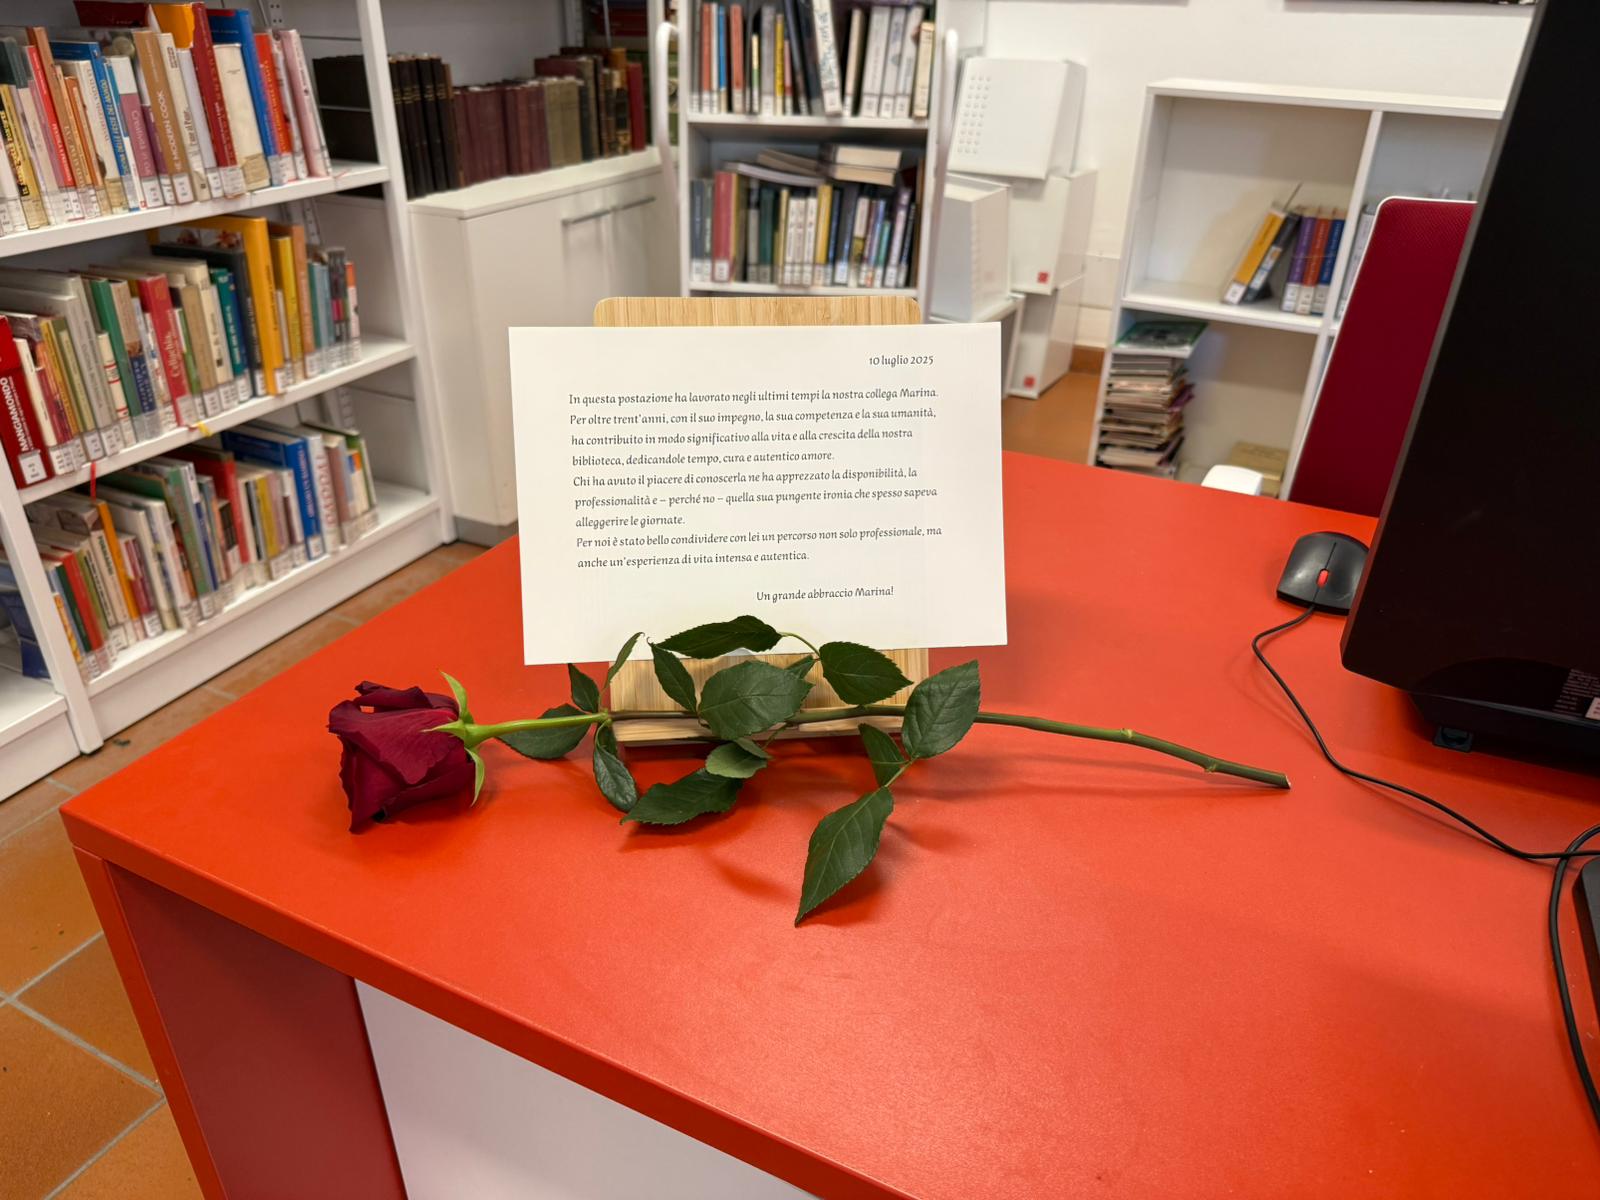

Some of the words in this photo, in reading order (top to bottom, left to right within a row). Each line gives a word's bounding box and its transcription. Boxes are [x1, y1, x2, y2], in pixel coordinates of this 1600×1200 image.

[155, 89, 171, 120] COOK
[164, 119, 182, 159] MODERN
[869, 357, 880, 365] 10
[882, 355, 908, 368] luglio
[910, 356, 933, 365] 2025
[569, 394, 580, 404] In
[583, 395, 616, 407] questa
[618, 393, 673, 406] postazione
[675, 392, 687, 402] ha
[689, 392, 730, 402] lavorato
[732, 391, 756, 404] negli
[758, 390, 788, 401] ultimi
[791, 390, 819, 403] tempi
[822, 390, 830, 399] la
[832, 391, 864, 399] nostra
[865, 389, 897, 401] collega
[900, 388, 938, 397] Marina.
[0, 377, 30, 452] MANGIAMONDO
[571, 415, 586, 424] Per
[588, 414, 611, 424] oltre
[614, 413, 669, 424] trent'anni,
[690, 412, 696, 422] il
[718, 413, 763, 425] impegno,
[766, 410, 774, 421] la
[795, 411, 853, 423] competenza
[862, 409, 870, 419] la
[891, 408, 936, 418] umanità,
[572, 435, 584, 445] ha
[586, 434, 643, 445] contribuito
[645, 434, 655, 444] in
[658, 433, 685, 443] modo
[687, 432, 750, 446] significativo
[751, 432, 769, 441] alla
[771, 432, 791, 441] vita
[799, 430, 817, 440] alla
[819, 430, 856, 440] crescita
[858, 429, 880, 439] della
[882, 430, 912, 438] nostra
[573, 456, 624, 466] biblioteca,
[626, 454, 685, 464] dedicandole
[688, 456, 721, 466] tempo,
[753, 451, 799, 462] autentico
[573, 476, 590, 486] Chi
[593, 476, 605, 486] ha
[607, 477, 636, 485] avuto
[638, 475, 644, 484] il
[647, 475, 682, 487] piacere
[684, 474, 694, 484] di
[696, 472, 746, 483] conoscerla
[762, 472, 774, 481] ha
[776, 472, 830, 484] apprezzato
[832, 470, 840, 479] la
[842, 468, 906, 482] disponibilità,
[909, 467, 917, 477] la
[575, 495, 650, 510] professionalità
[669, 494, 701, 507] perché
[726, 492, 754, 505] quella
[776, 492, 821, 504] pungente
[824, 490, 853, 499] ironia
[855, 489, 870, 498] che
[872, 491, 902, 501] spesso
[904, 489, 937, 499] sapeva
[576, 517, 628, 530] alleggerire
[631, 516, 638, 525] le
[640, 516, 685, 528] giornate.
[577, 538, 592, 547] Per
[594, 537, 610, 546] noi
[613, 537, 618, 546] è
[619, 538, 645, 546] stato
[647, 535, 669, 545] bello
[671, 533, 728, 544] condividere
[749, 532, 760, 541] lei
[777, 533, 817, 544] percorso
[839, 528, 857, 538] solo
[860, 526, 924, 540] professionale,
[578, 557, 608, 568] anche
[610, 556, 680, 568] un'esperienza
[682, 554, 691, 564] di
[694, 554, 713, 563] vita
[715, 554, 752, 563] intensa
[761, 551, 809, 561] autentica.
[757, 592, 770, 600] Un
[772, 589, 806, 603] grande
[808, 588, 853, 598] abbraccio
[855, 586, 893, 596] Marina!
